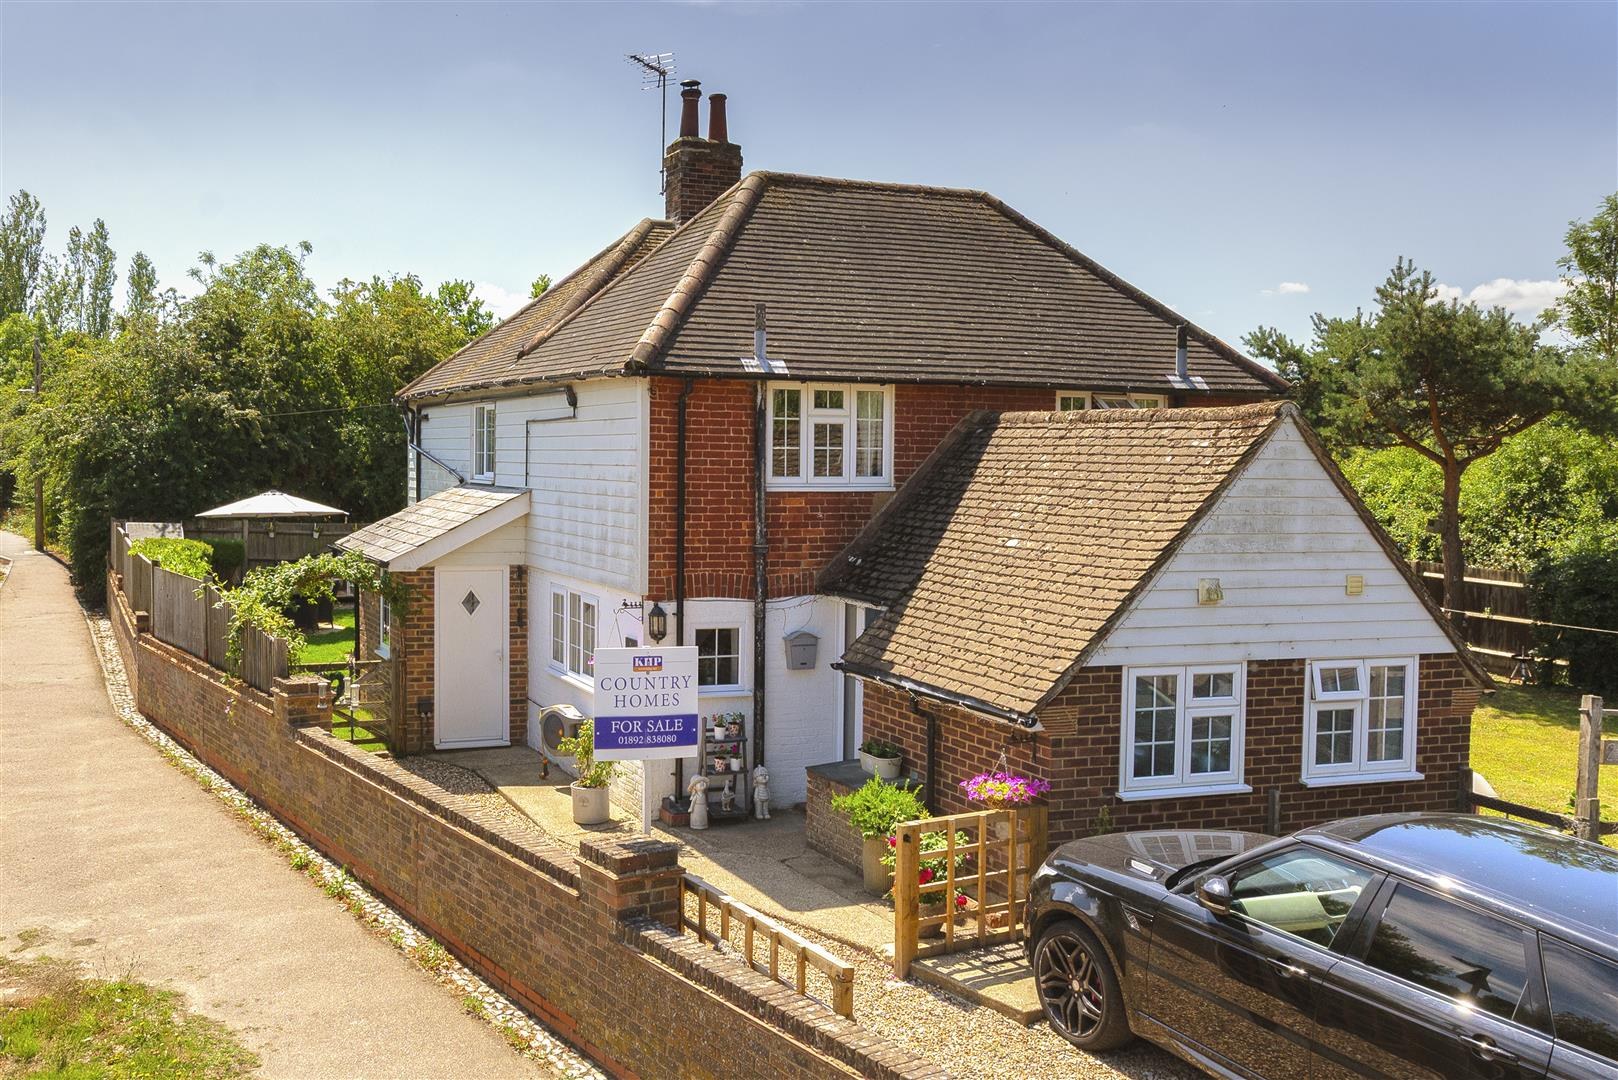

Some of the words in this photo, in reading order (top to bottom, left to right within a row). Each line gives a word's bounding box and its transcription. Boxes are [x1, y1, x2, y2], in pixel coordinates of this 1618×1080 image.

[635, 657, 661, 666] KHP
[601, 676, 691, 690] COUNTRY
[614, 693, 680, 708] HOMES
[611, 720, 642, 733] FOR
[647, 719, 683, 733] SALE
[618, 736, 644, 745] 01892
[646, 734, 677, 744] 838080
